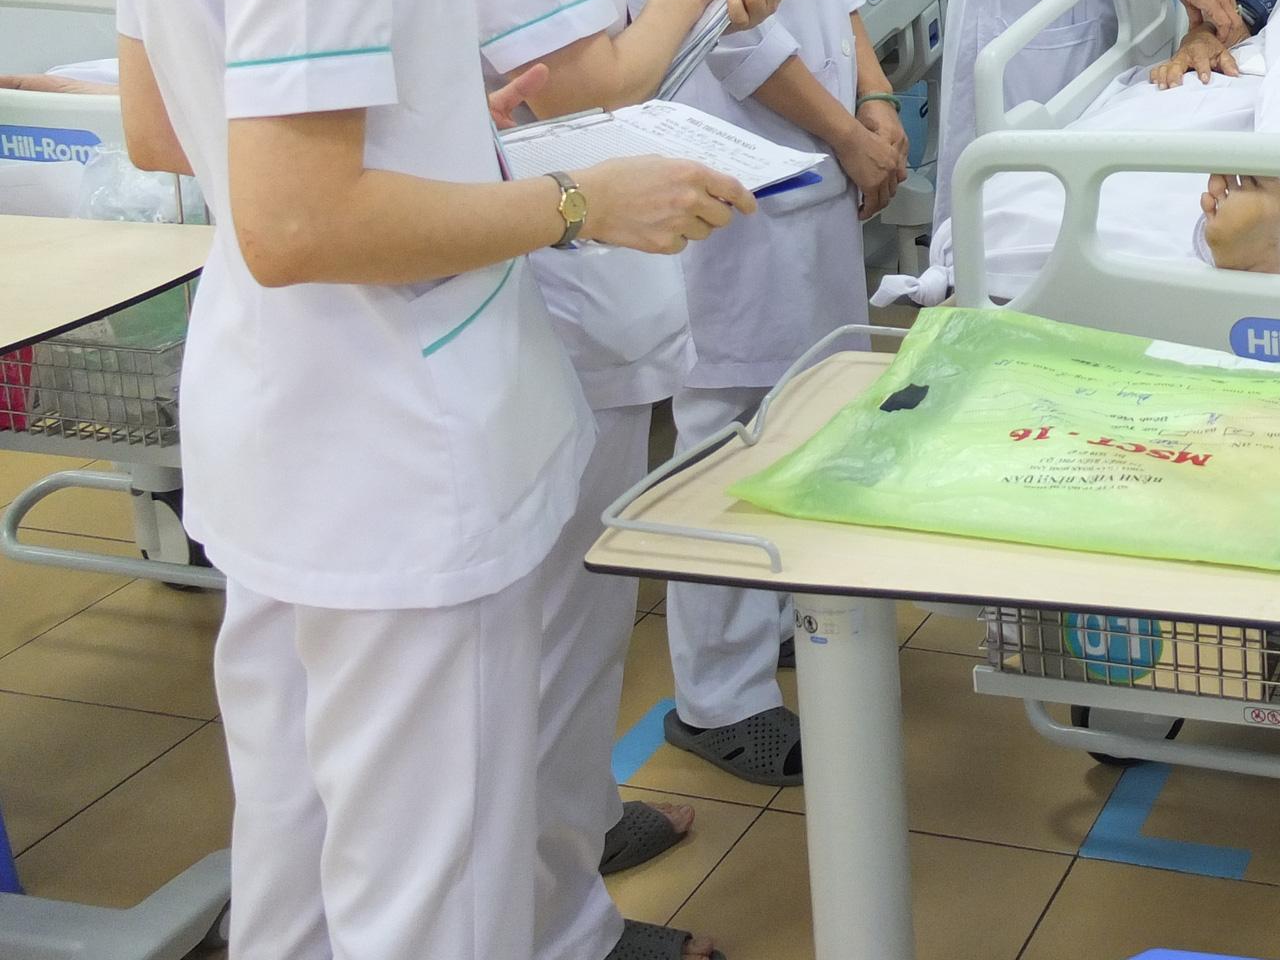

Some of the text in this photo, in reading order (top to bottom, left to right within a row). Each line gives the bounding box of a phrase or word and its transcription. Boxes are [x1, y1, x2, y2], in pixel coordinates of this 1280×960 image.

[1, 134, 92, 162] Hill-Rom
[1009, 426, 1055, 442] 16
[1087, 436, 1213, 467] MSCT
[1077, 611, 1141, 659] 01
